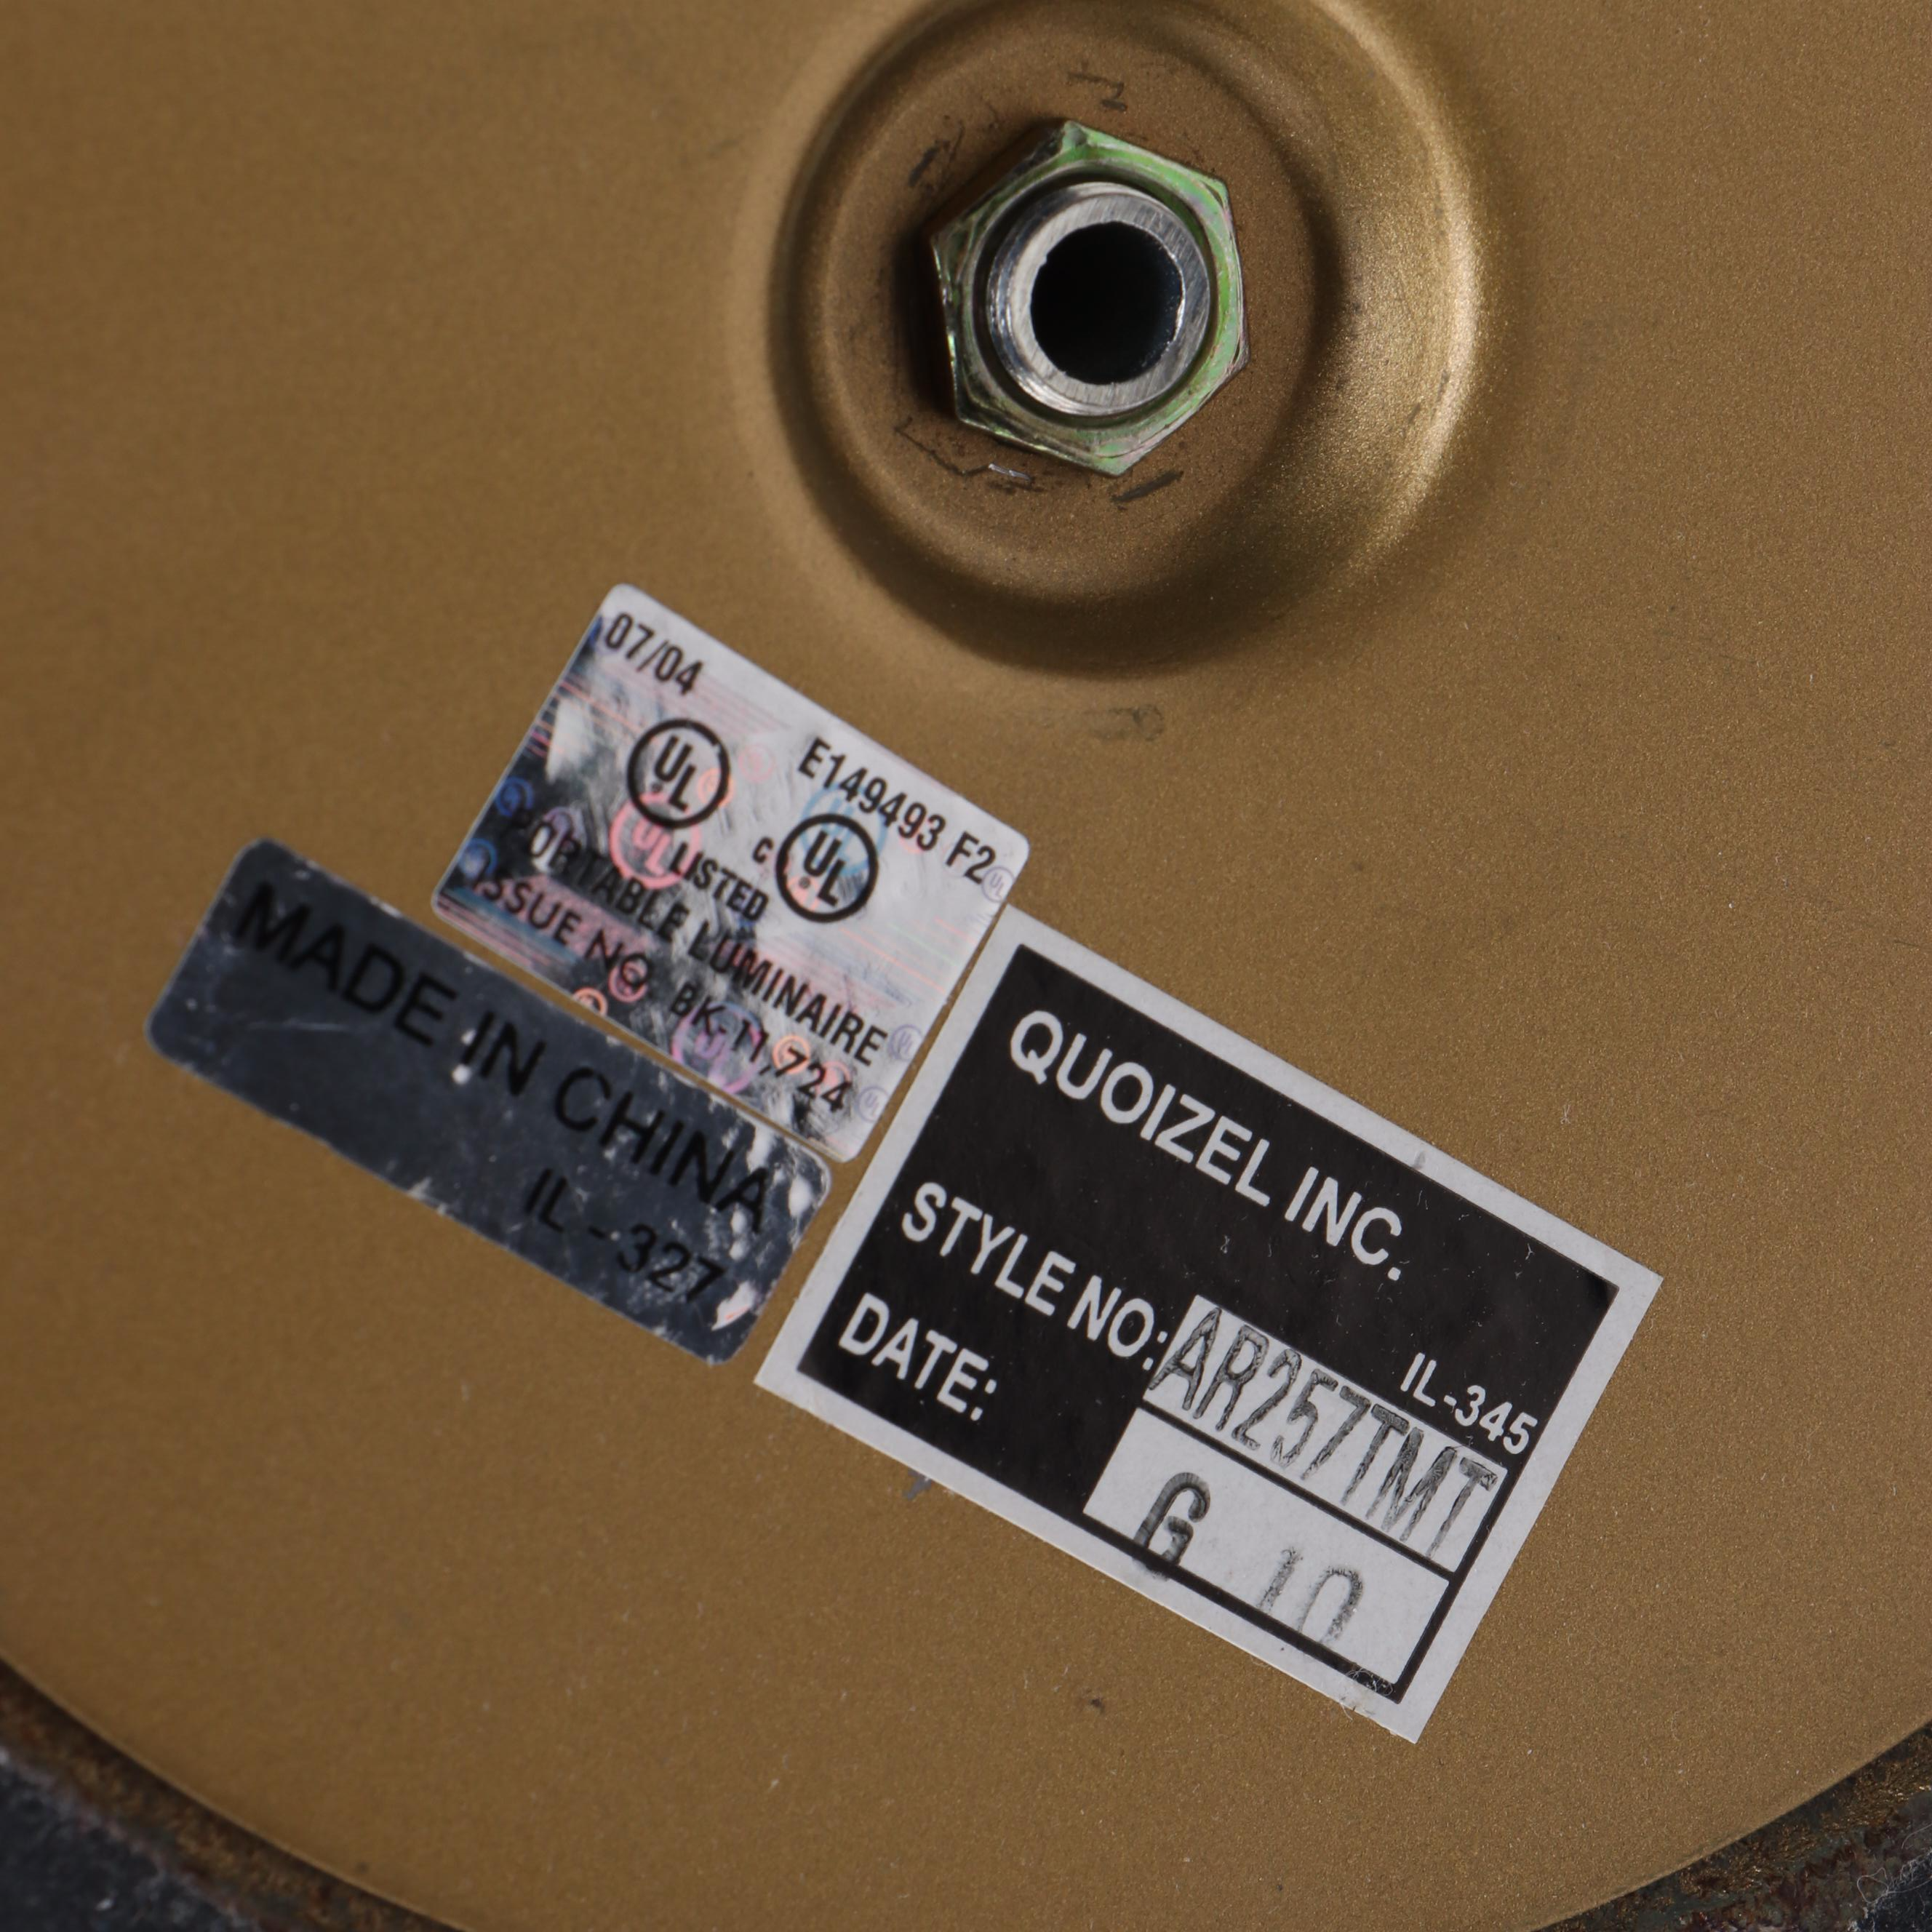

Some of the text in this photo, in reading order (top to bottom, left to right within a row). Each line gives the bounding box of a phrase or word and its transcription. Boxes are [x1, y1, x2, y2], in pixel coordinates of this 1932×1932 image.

[604, 612, 703, 695] 07/04
[669, 842, 769, 922] LISTED
[797, 736, 997, 885] E149493 F2
[472, 854, 581, 946] ISSUE
[671, 983, 853, 1112] BK-11,724
[688, 919, 887, 1066] LUMINAIRE
[235, 882, 767, 1233] MADE IN CHINA
[1010, 1010, 1402, 1281] QUOIZEL INC.
[838, 1293, 997, 1421] DATE:
[902, 1182, 1498, 1560] STYLE NO: AR257TMT
[1400, 1352, 1538, 1455] IL-345
